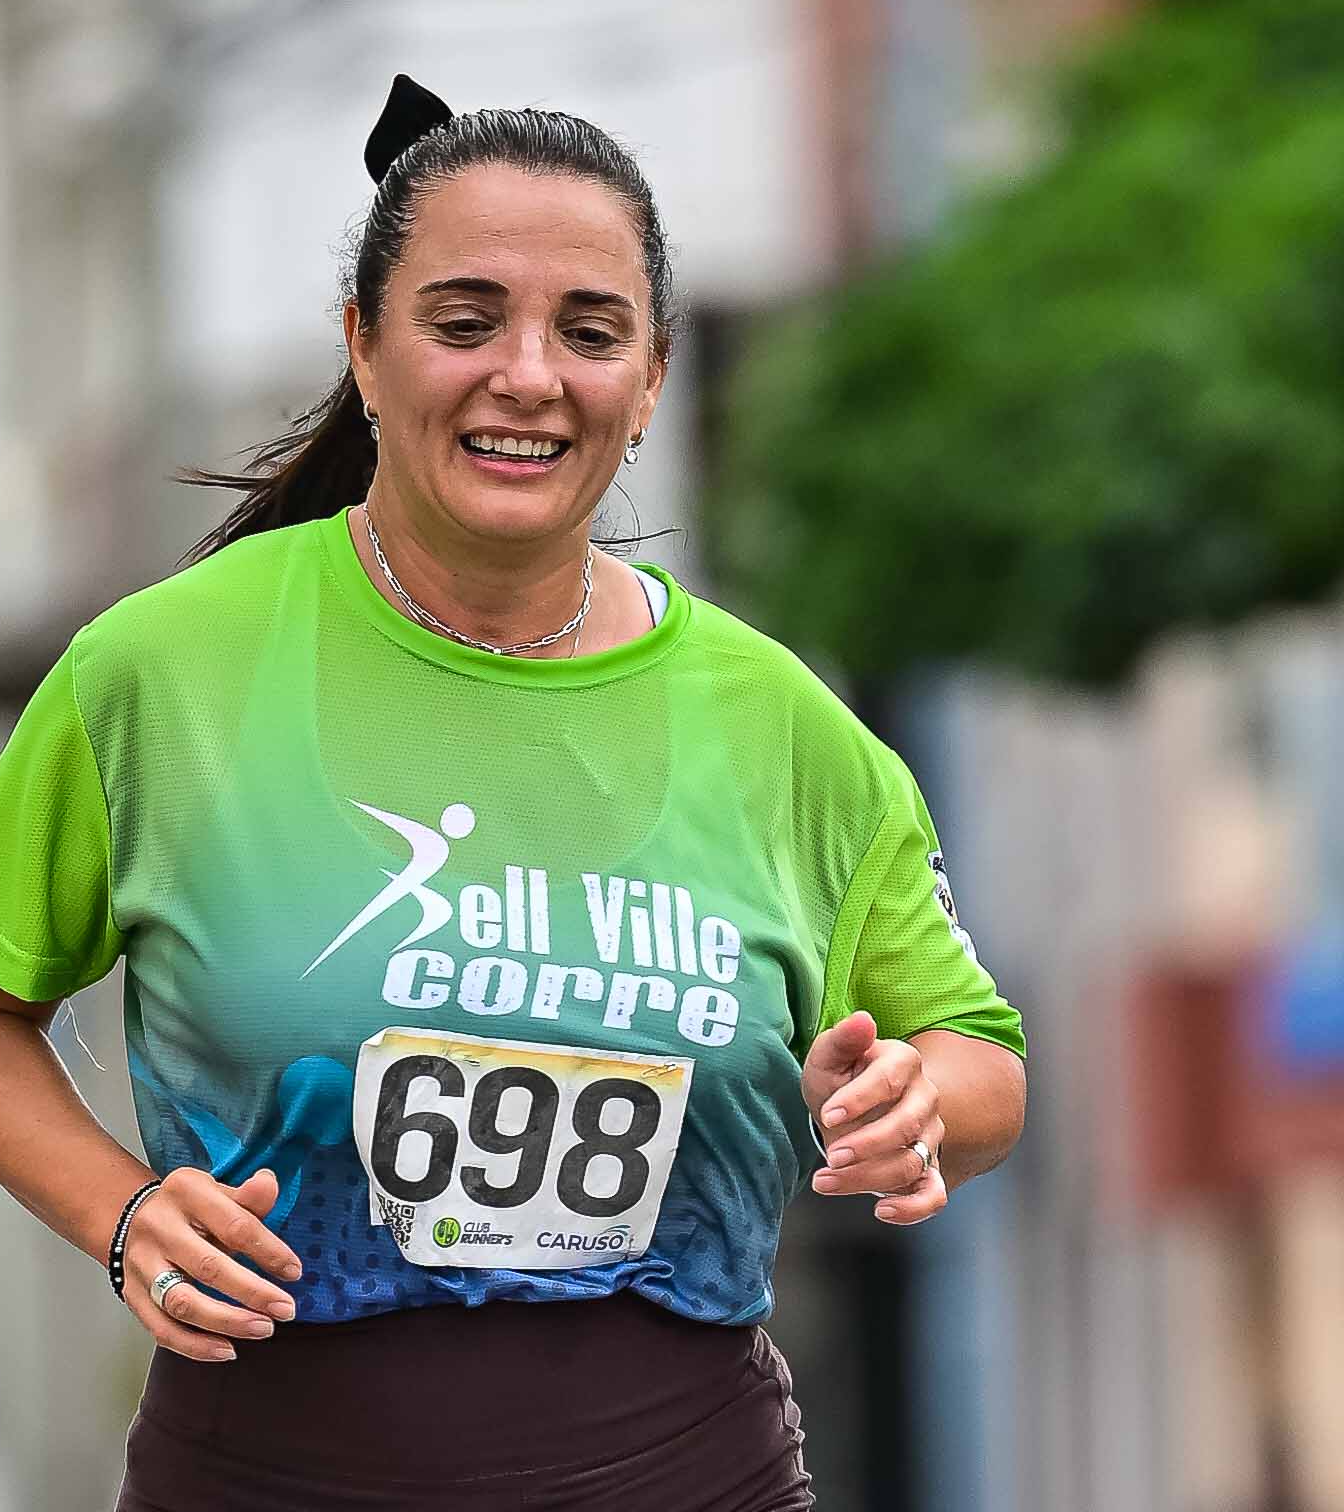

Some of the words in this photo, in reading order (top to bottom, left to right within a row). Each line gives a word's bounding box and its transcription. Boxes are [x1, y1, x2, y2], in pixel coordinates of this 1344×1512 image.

[581, 872, 742, 985] Ville
[381, 948, 741, 1048] corre
[370, 1054, 662, 1218] 698
[463, 1222, 491, 1233] CLUB
[536, 1231, 624, 1251] CARUSO
